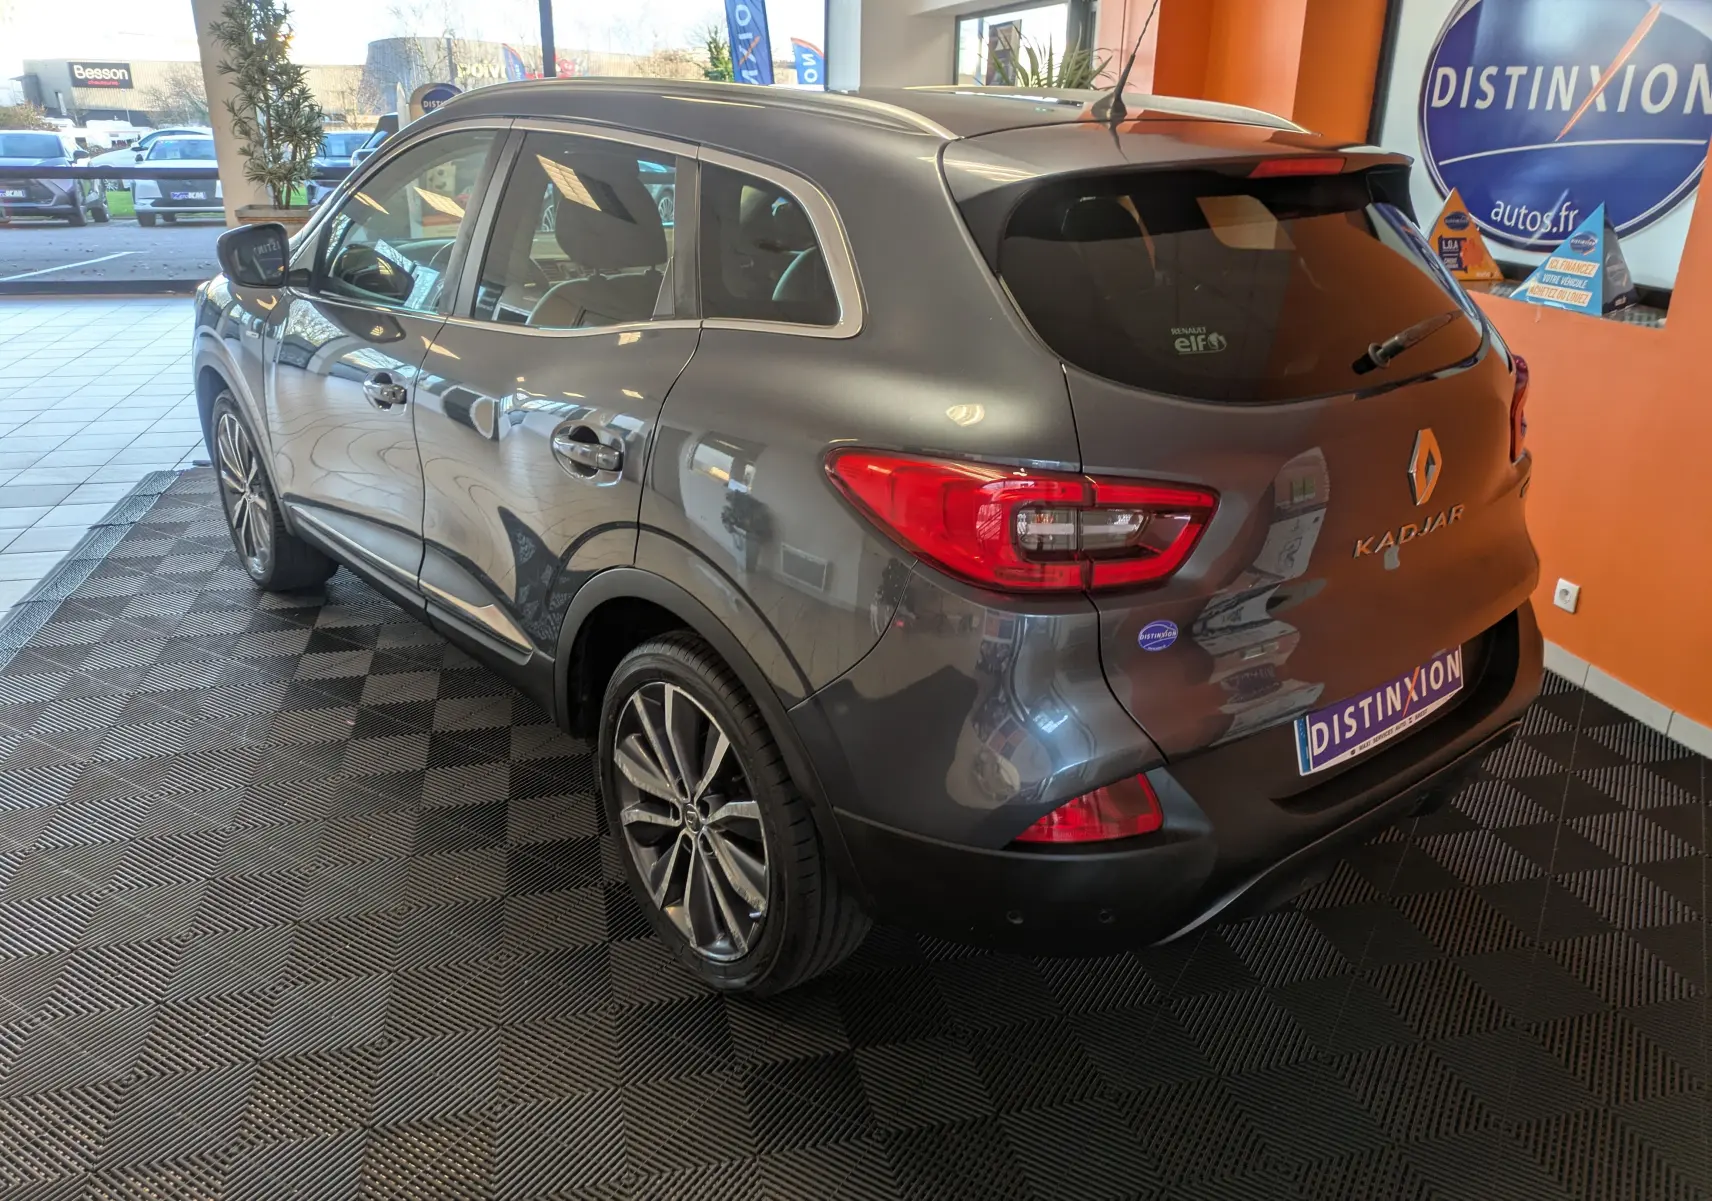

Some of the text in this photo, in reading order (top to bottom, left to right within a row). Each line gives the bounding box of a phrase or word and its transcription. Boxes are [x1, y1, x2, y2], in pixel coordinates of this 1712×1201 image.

[73, 64, 129, 80] Besson
[1430, 62, 1712, 116] DISTINXION
[1489, 200, 1579, 233] autos.fr
[1560, 259, 1597, 275] FINANCEZ
[1542, 273, 1560, 284] VOTRE
[1529, 284, 1589, 304] ACHETEZ OU LOUEZ
[1171, 326, 1207, 335] RENAULT
[1174, 335, 1207, 352] elf
[1352, 504, 1465, 559] KADJAR
[1139, 630, 1177, 640] DISTINXION
[1311, 650, 1461, 757] DISTINXION
[1372, 727, 1394, 744] SERVICES
